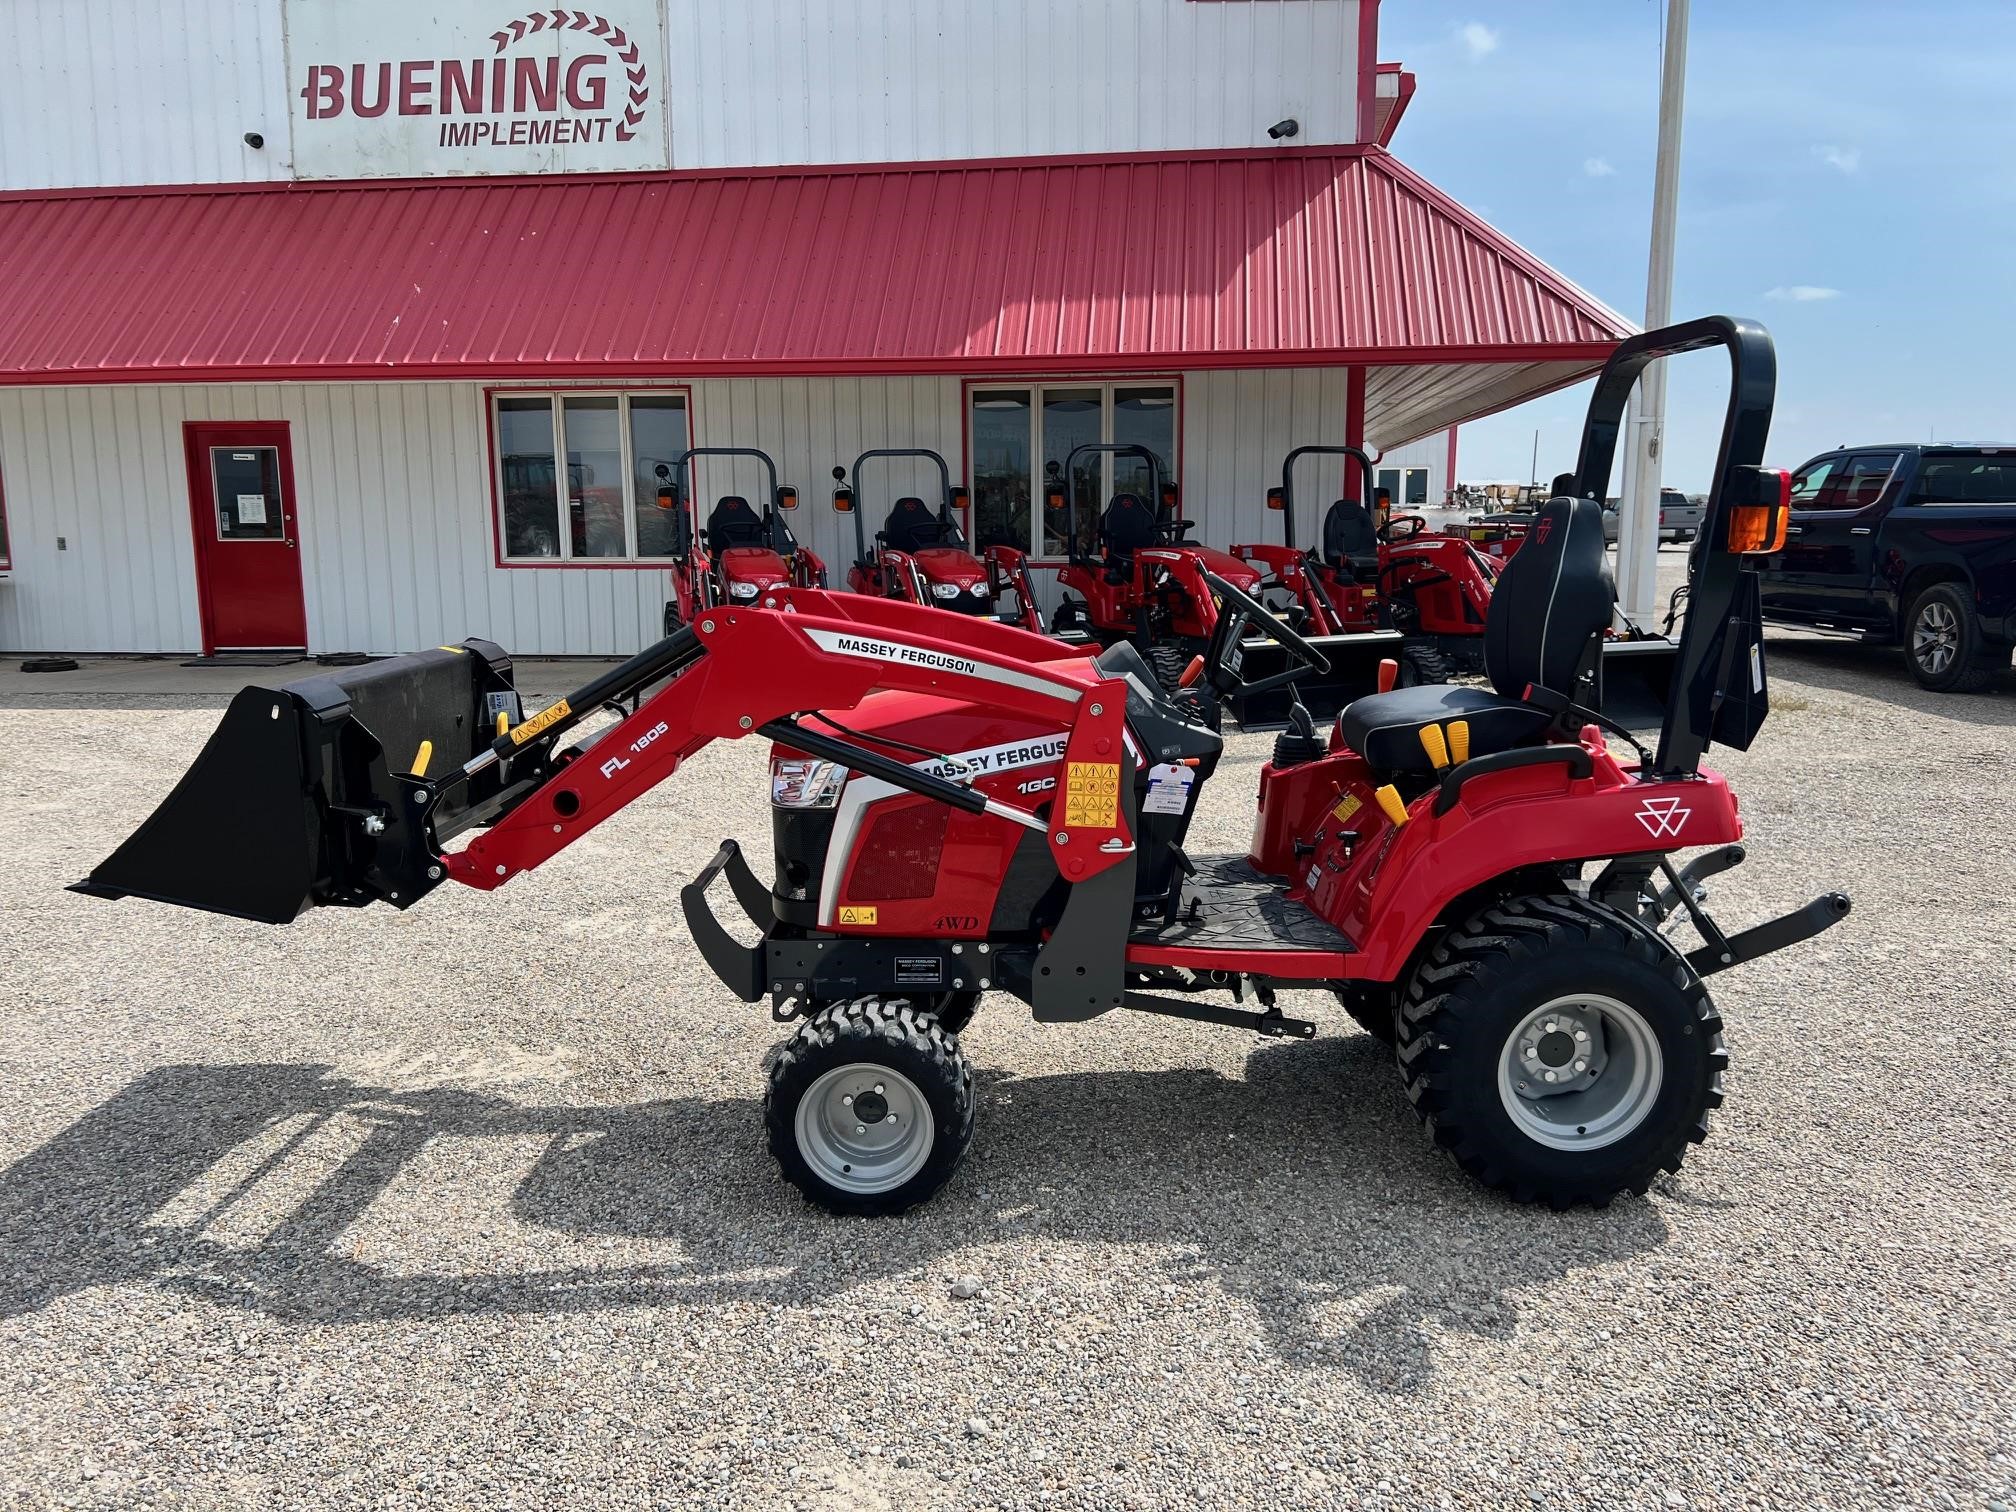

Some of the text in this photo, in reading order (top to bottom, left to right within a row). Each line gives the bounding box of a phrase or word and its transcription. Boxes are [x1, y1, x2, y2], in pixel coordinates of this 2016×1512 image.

[301, 54, 607, 120] BUENING
[439, 117, 612, 147] IMPLEMENT
[838, 638, 976, 674] MASSEY FERGUSON
[599, 721, 669, 780] FL 1805
[934, 916, 979, 930] 4WD
